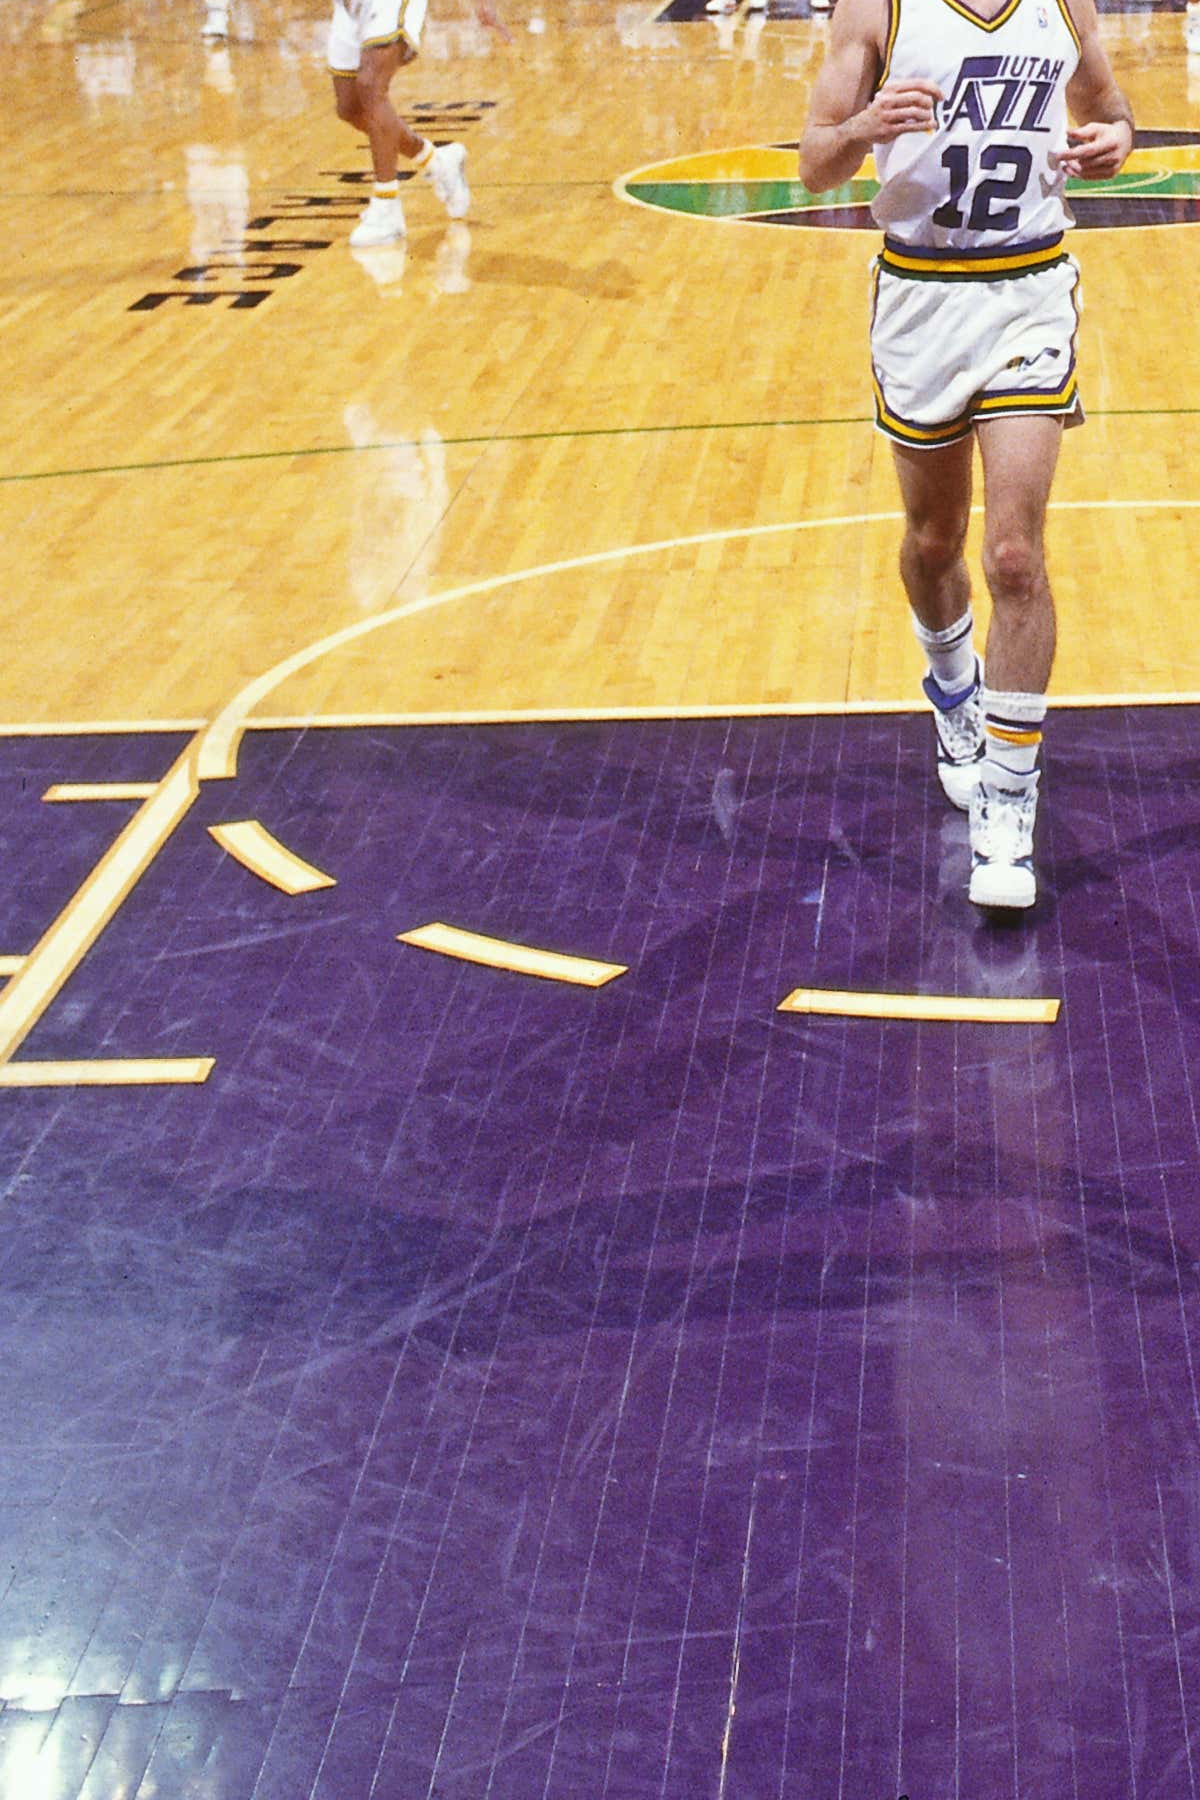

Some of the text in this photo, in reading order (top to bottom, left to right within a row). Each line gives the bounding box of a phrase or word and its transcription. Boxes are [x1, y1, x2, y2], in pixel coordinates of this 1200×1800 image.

[942, 55, 1056, 133] JAZZ
[1009, 55, 1065, 82] UTAH
[932, 144, 1034, 232] 12
